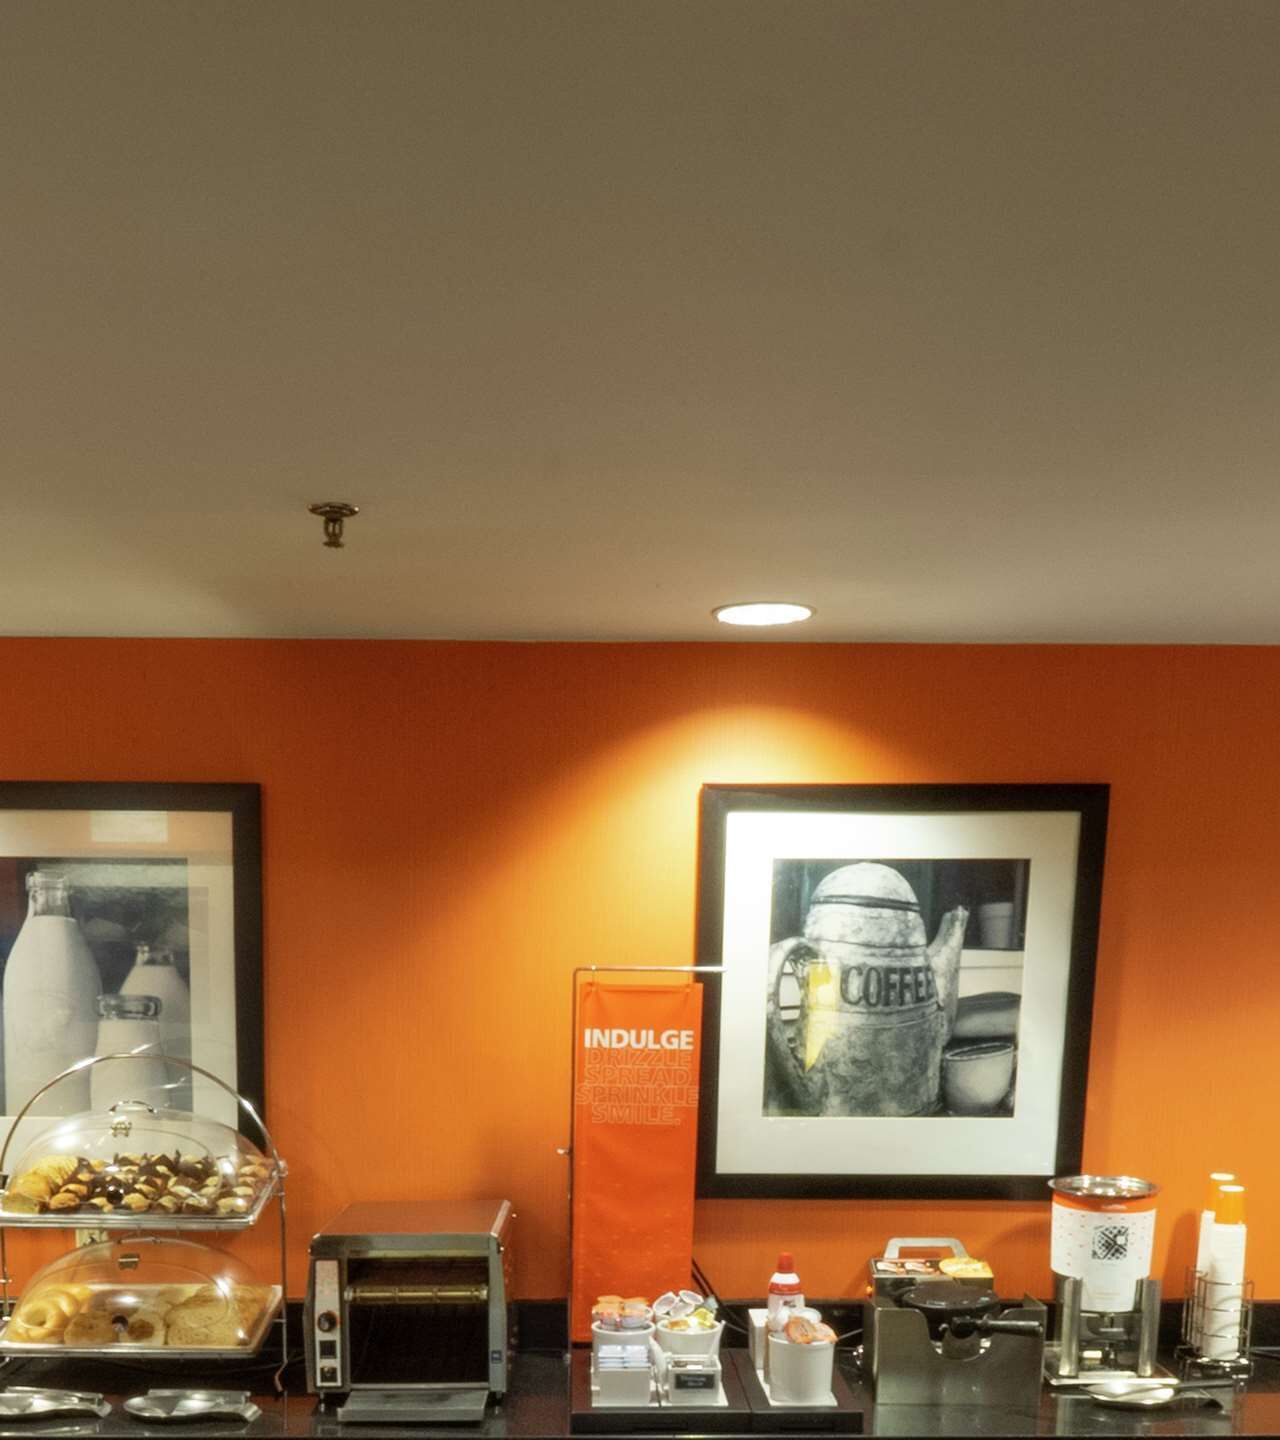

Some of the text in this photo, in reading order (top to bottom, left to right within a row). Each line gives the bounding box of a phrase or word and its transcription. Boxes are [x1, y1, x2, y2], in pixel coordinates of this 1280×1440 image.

[840, 965, 936, 1007] COFFEE
[584, 1028, 694, 1050] INDULGE
[585, 1048, 694, 1069] DRIZZLE
[584, 1065, 692, 1087] SPREAD
[576, 1083, 699, 1107] SPRINKLE
[592, 1103, 681, 1126] SMILE.
